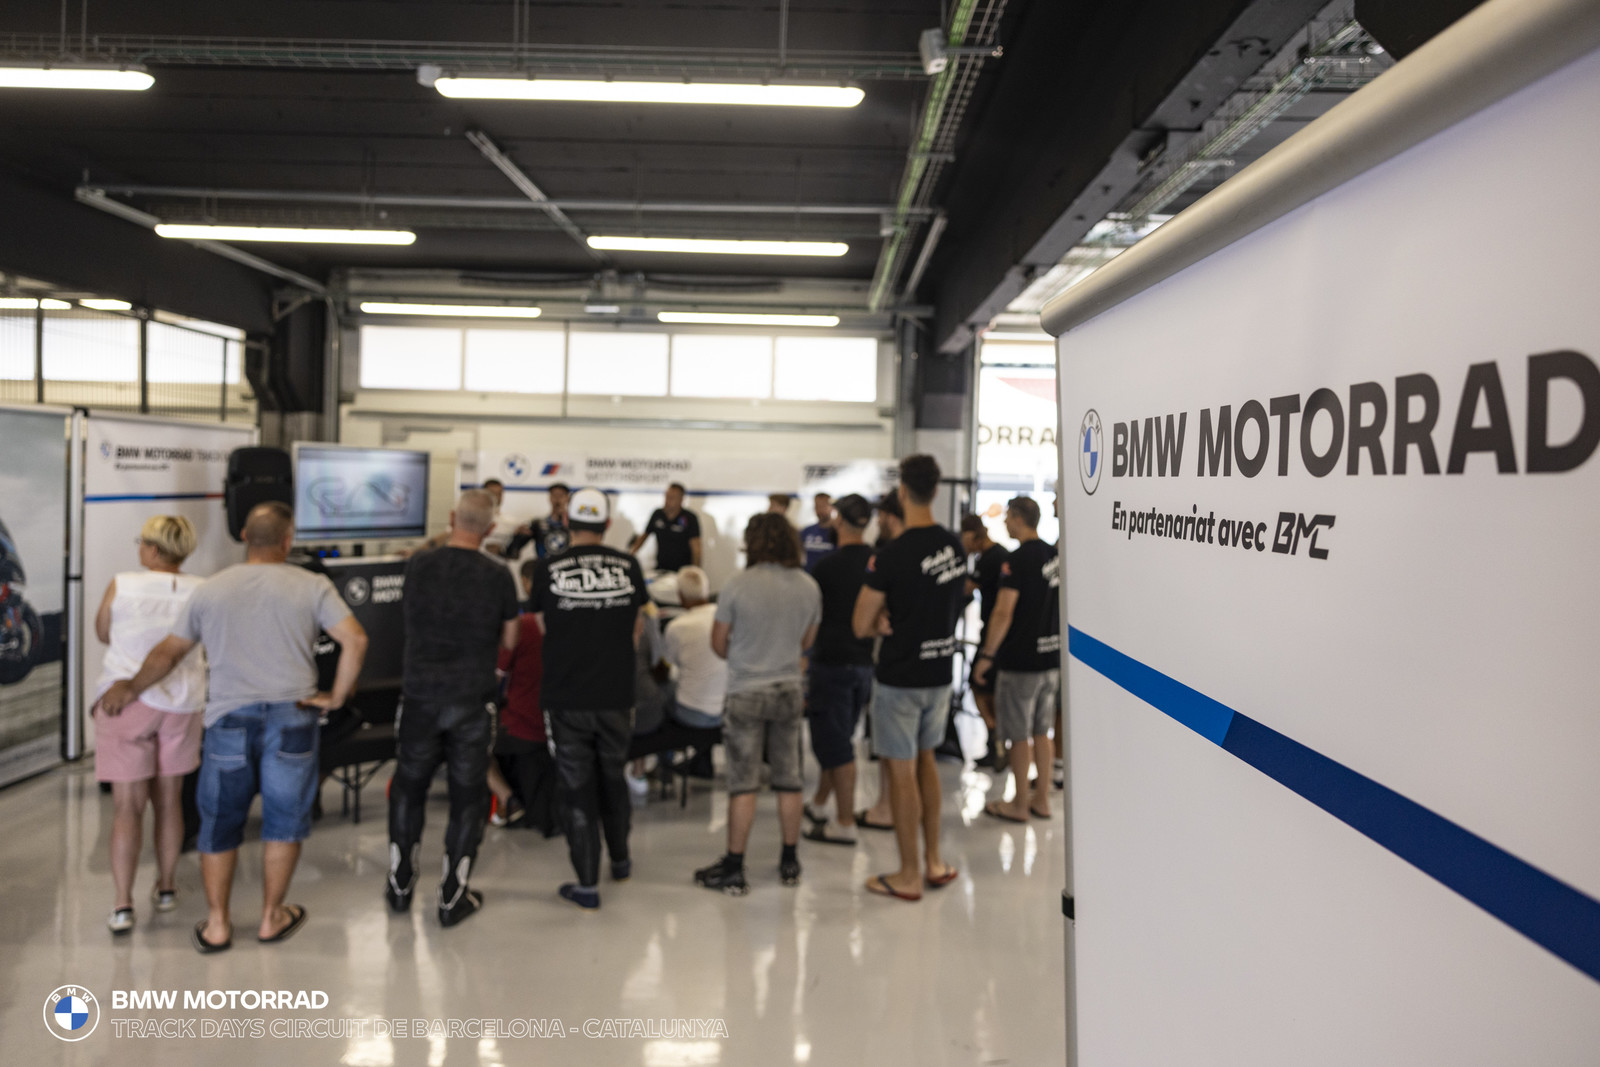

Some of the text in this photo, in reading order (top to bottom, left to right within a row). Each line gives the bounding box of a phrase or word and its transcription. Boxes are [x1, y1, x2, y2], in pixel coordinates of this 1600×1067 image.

[1112, 349, 1600, 479] BMW MOTORRAD
[1111, 500, 1336, 560] En partenariat avec BMC
